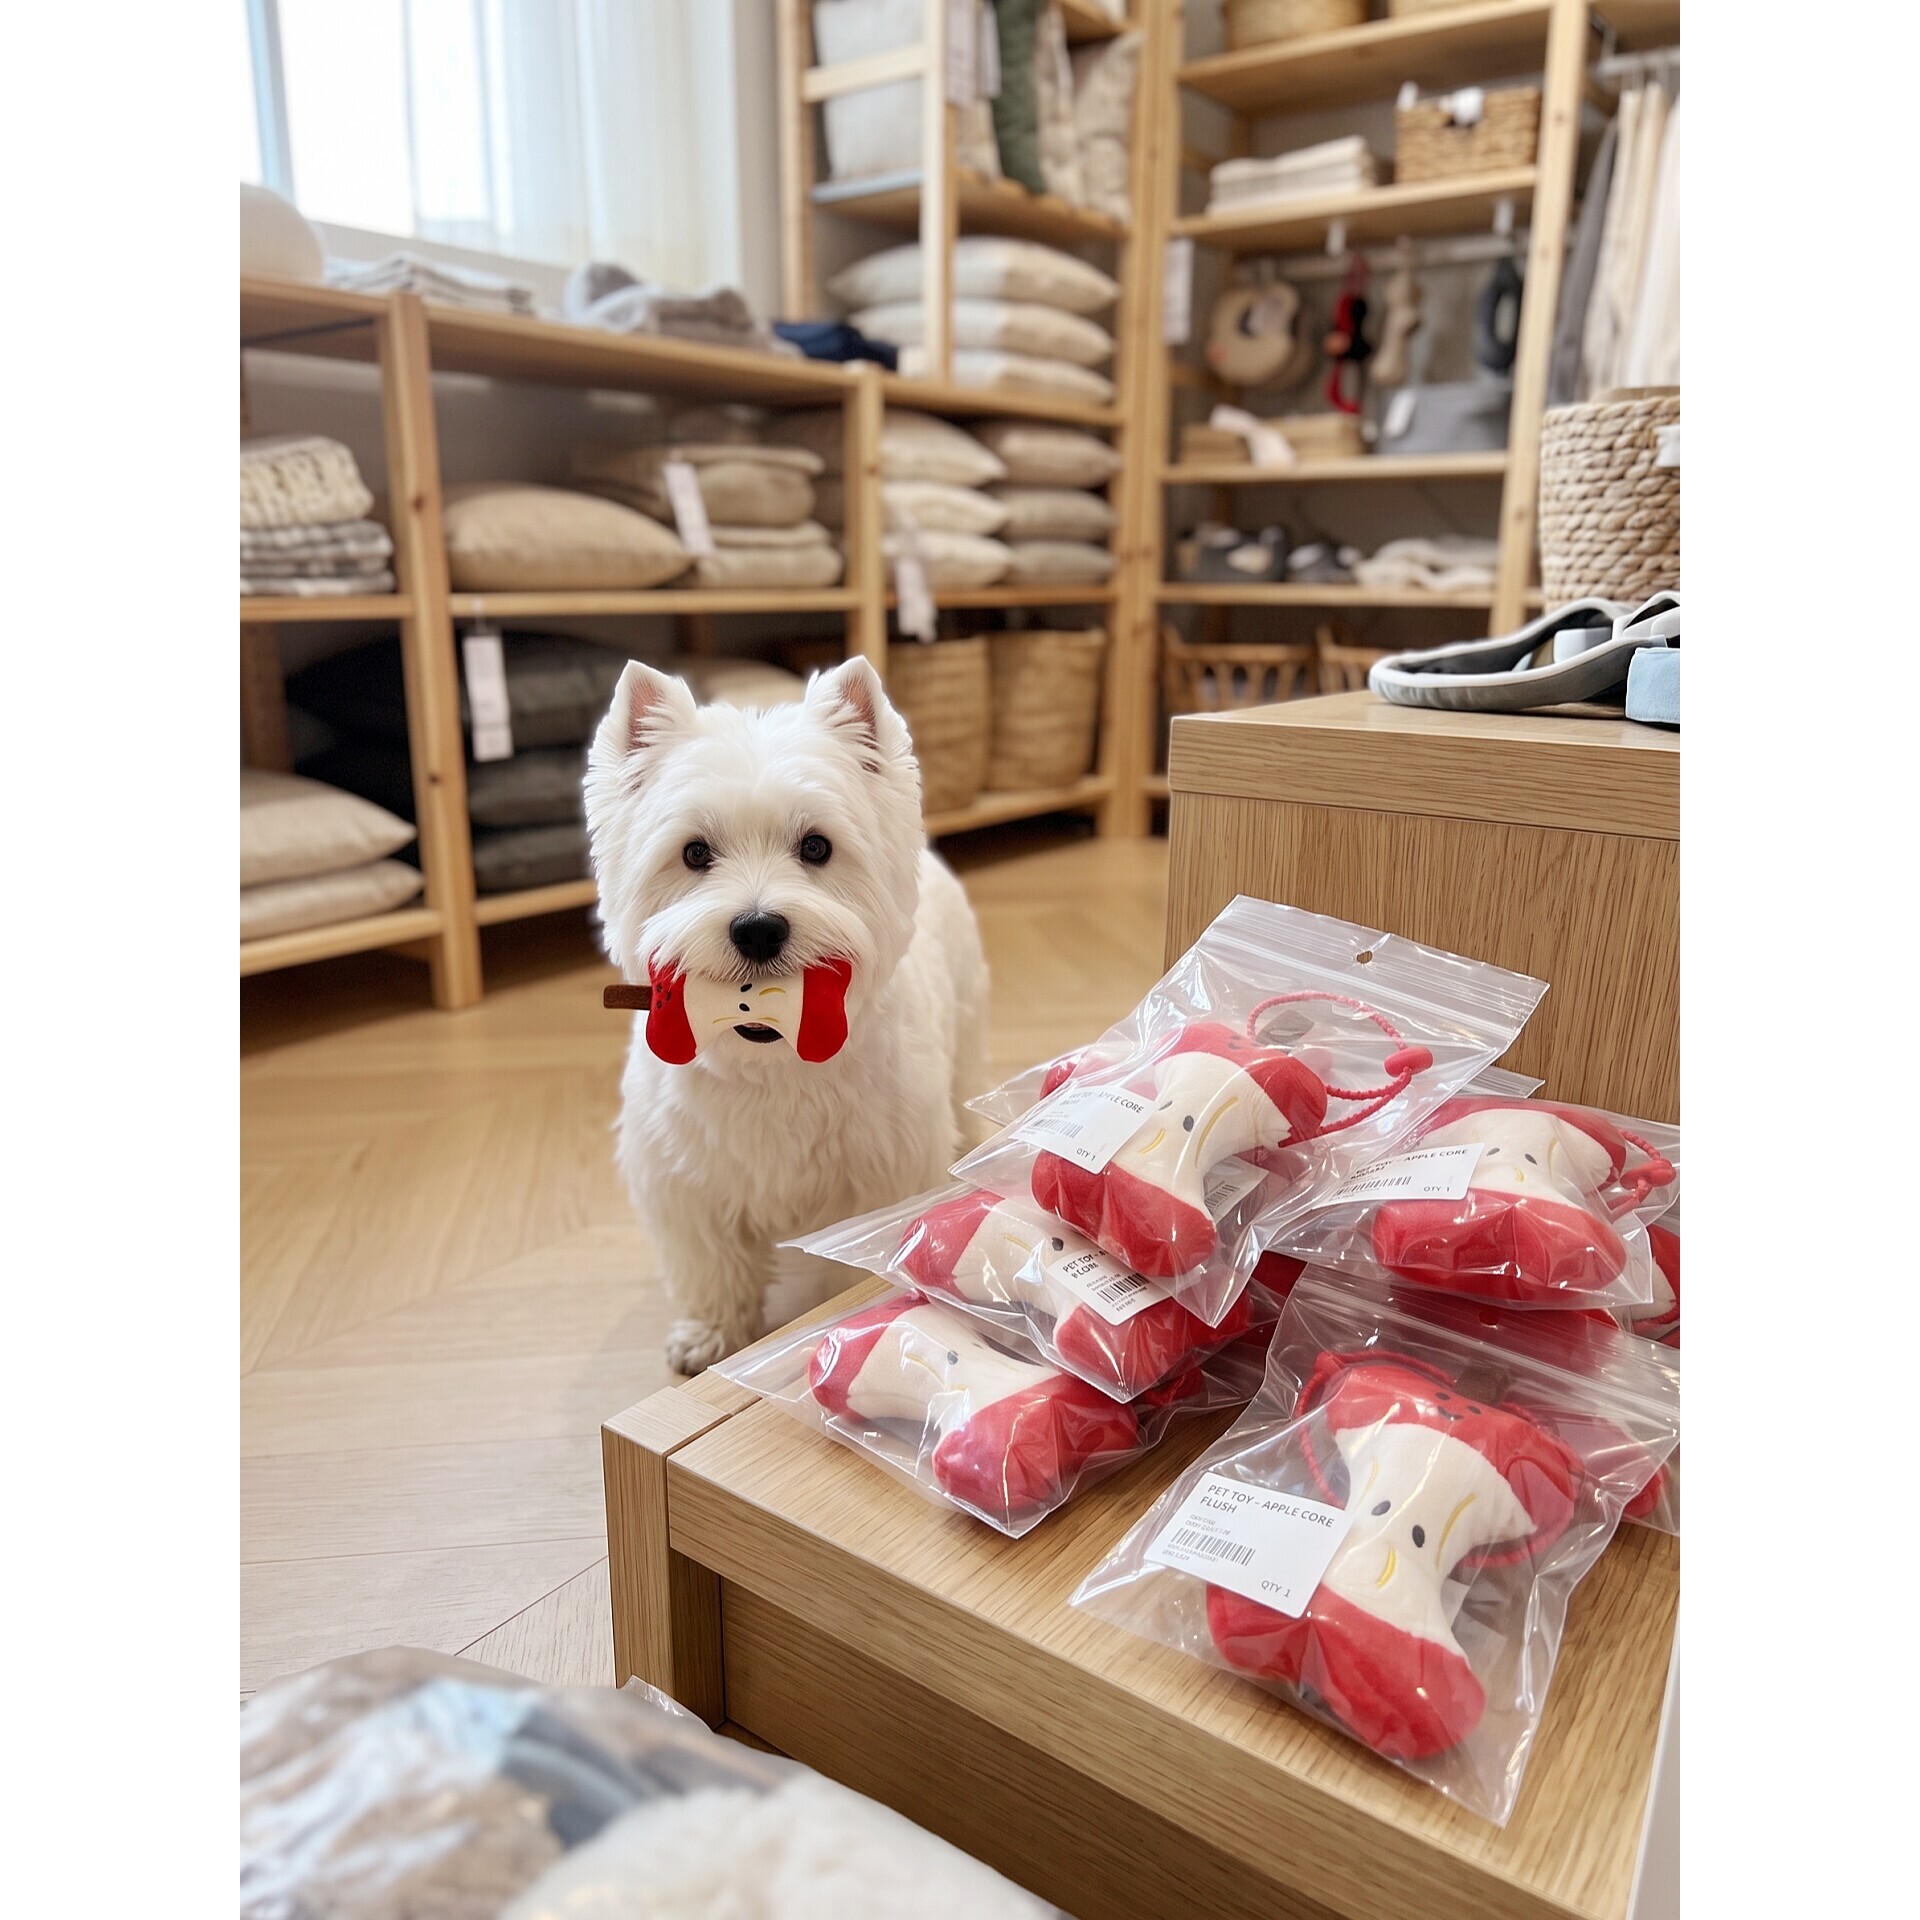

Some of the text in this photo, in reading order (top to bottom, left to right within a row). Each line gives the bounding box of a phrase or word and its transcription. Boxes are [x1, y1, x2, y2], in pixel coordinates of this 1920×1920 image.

[1120, 1099, 1144, 1113] CORE
[1091, 1154, 1096, 1162] 1
[1404, 1152, 1436, 1162] APPLE
[1439, 1149, 1468, 1157] CORE
[1062, 1260, 1079, 1273] PET
[1200, 1496, 1238, 1513] FLUSH
[1207, 1484, 1230, 1497] PET
[1231, 1490, 1254, 1504] TOY
[1261, 1500, 1299, 1517] APPLE
[1301, 1510, 1335, 1527] CORE
[1261, 1580, 1291, 1597] QTY 1
